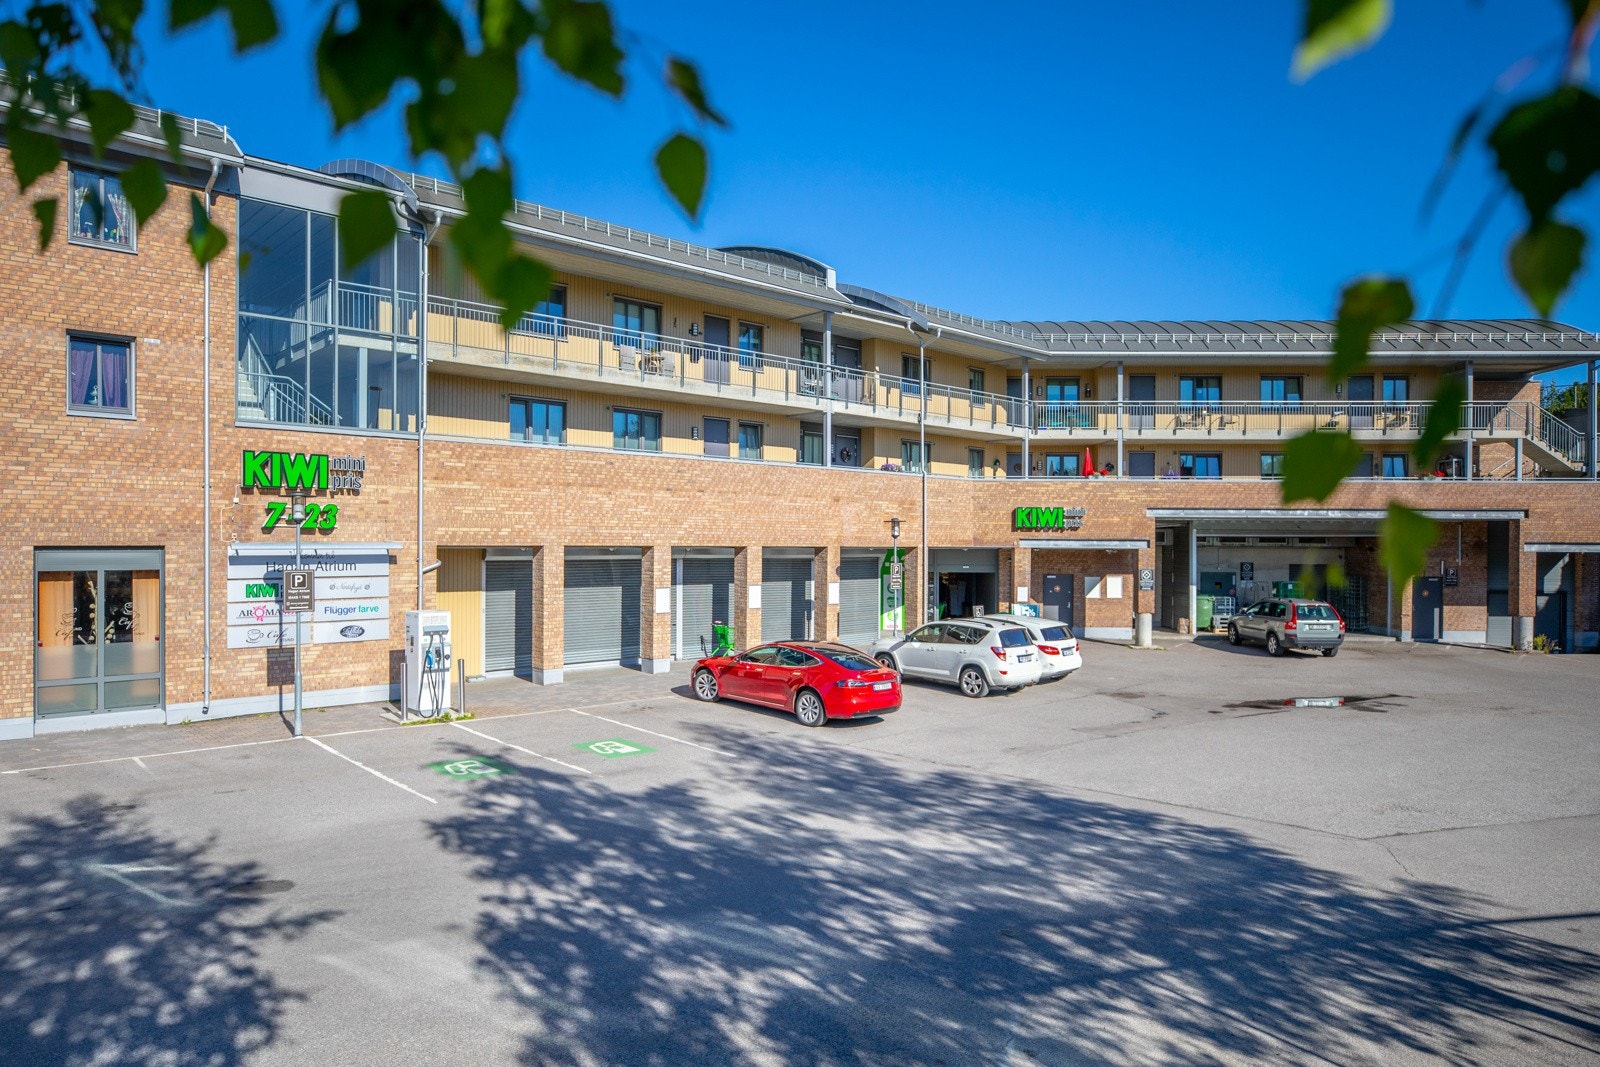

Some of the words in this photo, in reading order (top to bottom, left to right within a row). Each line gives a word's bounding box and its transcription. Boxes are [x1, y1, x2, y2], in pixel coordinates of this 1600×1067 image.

[243, 450, 329, 489] KIWI
[333, 455, 365, 470] mini
[333, 474, 361, 490] pris
[1016, 507, 1064, 528] KIWI
[316, 560, 357, 572] Atrium
[294, 575, 303, 587] P
[246, 583, 279, 598] KIWI
[324, 606, 356, 615] Flügger
[358, 605, 379, 613] farve
